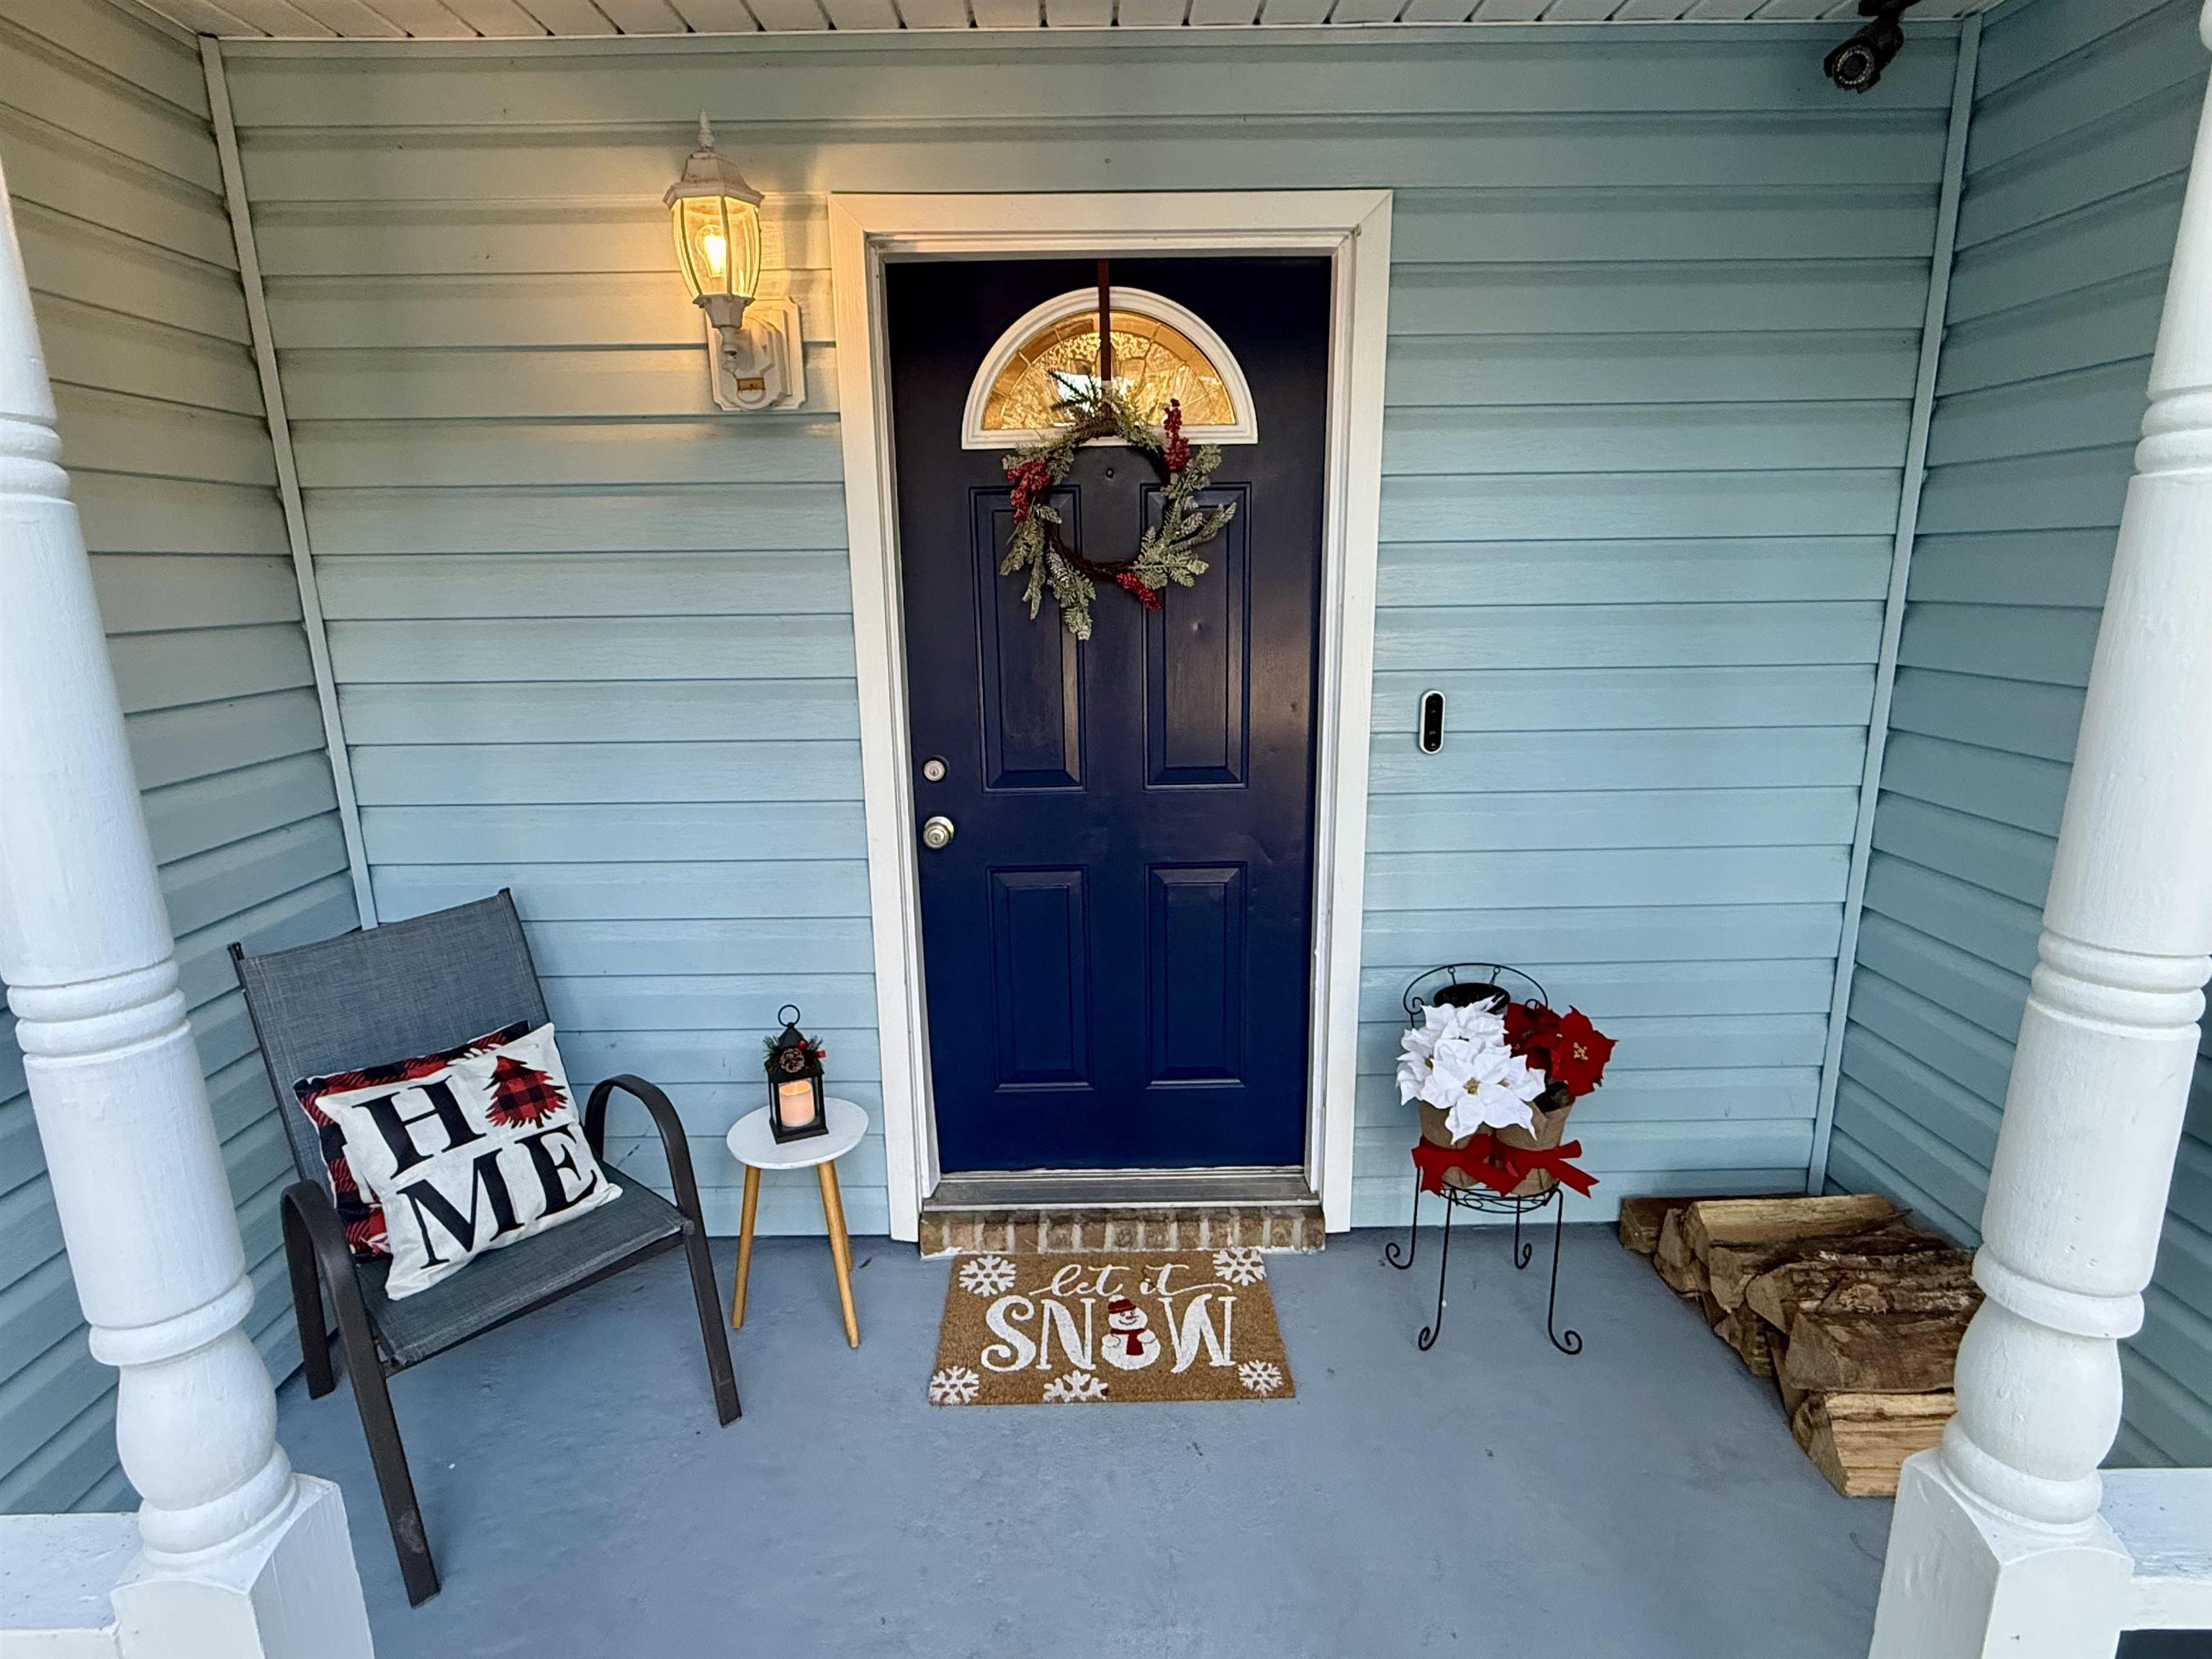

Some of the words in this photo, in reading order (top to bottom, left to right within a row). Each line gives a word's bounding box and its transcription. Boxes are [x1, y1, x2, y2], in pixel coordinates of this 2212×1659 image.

[396, 1123, 598, 1269] ME
[1028, 1264, 1130, 1297] let
[1140, 1263, 1233, 1296] it
[981, 1294, 1237, 1373] SNW
